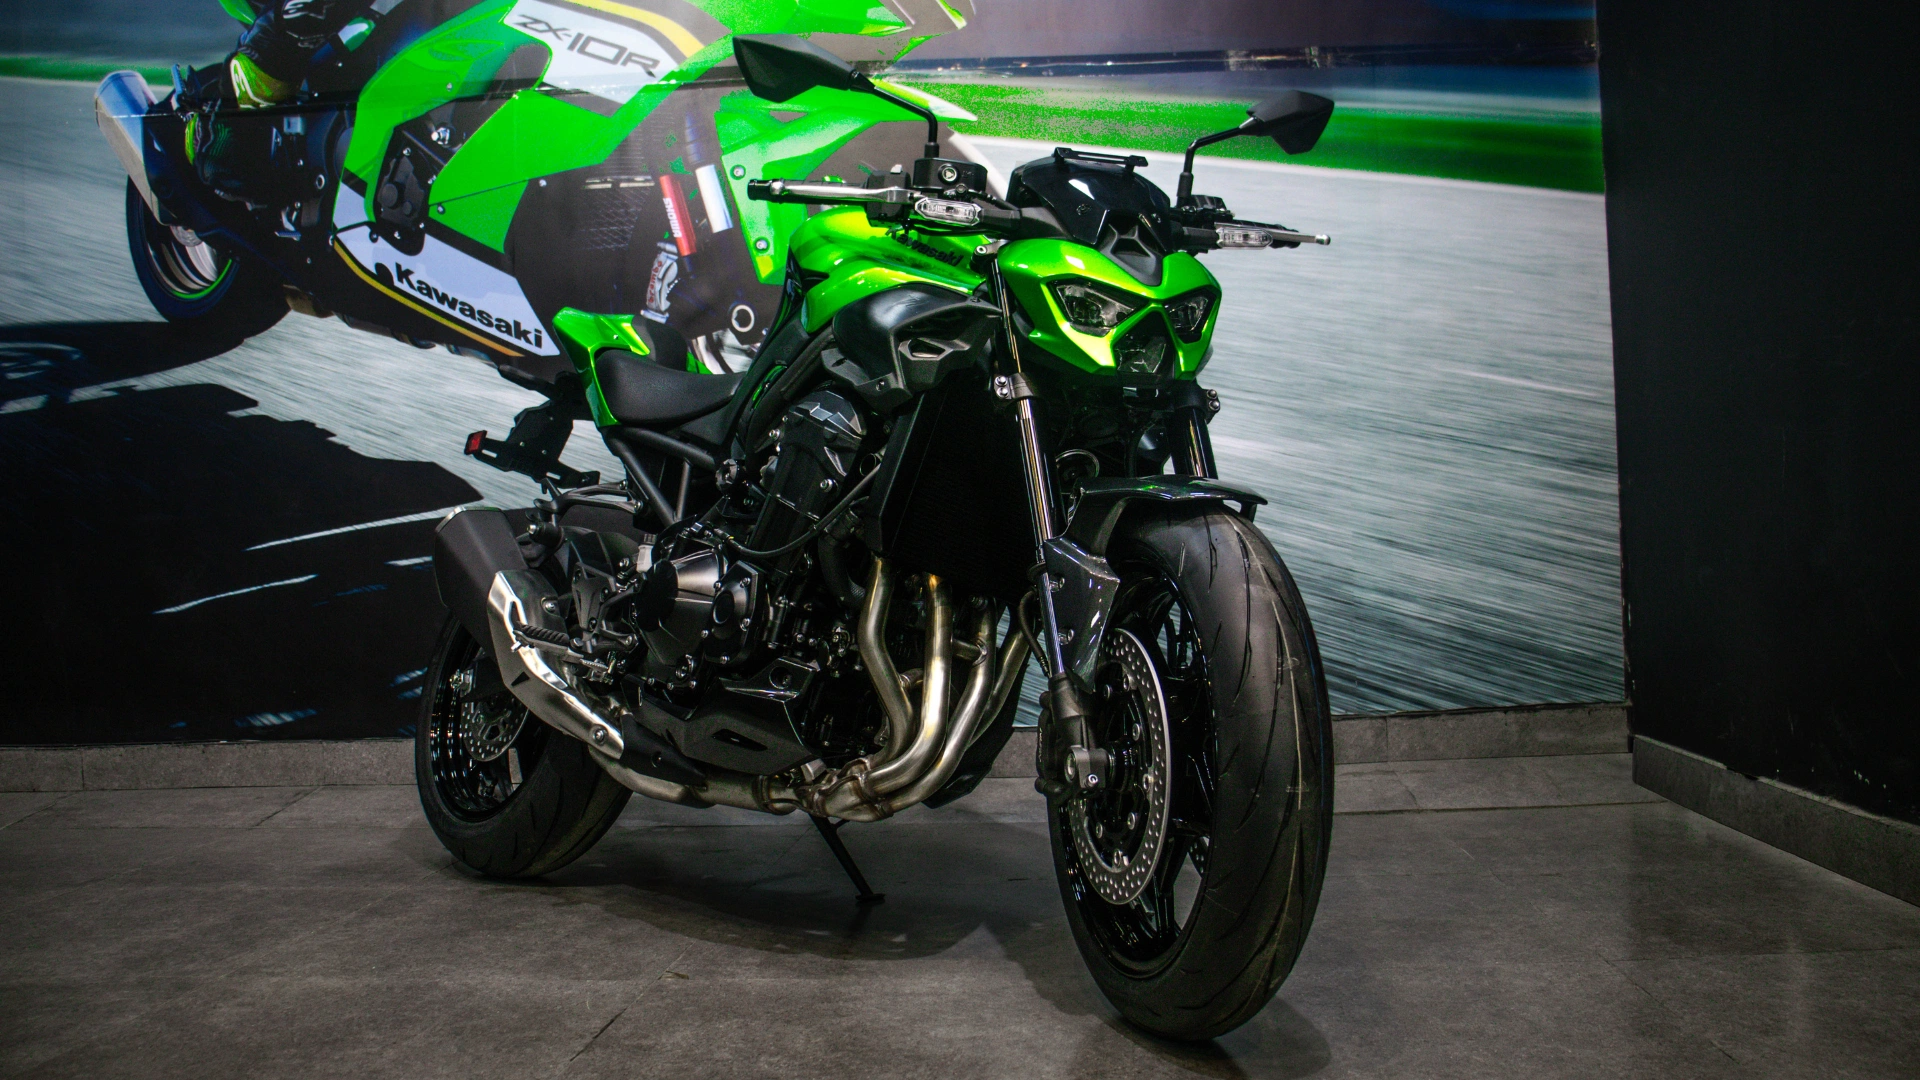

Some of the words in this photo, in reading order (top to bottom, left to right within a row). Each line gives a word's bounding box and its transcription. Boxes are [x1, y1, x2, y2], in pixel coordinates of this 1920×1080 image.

[514, 14, 660, 79] ZX-10R
[662, 197, 683, 238] SHOWA
[395, 261, 543, 350] Kawasaki
[647, 260, 663, 304] brembo
